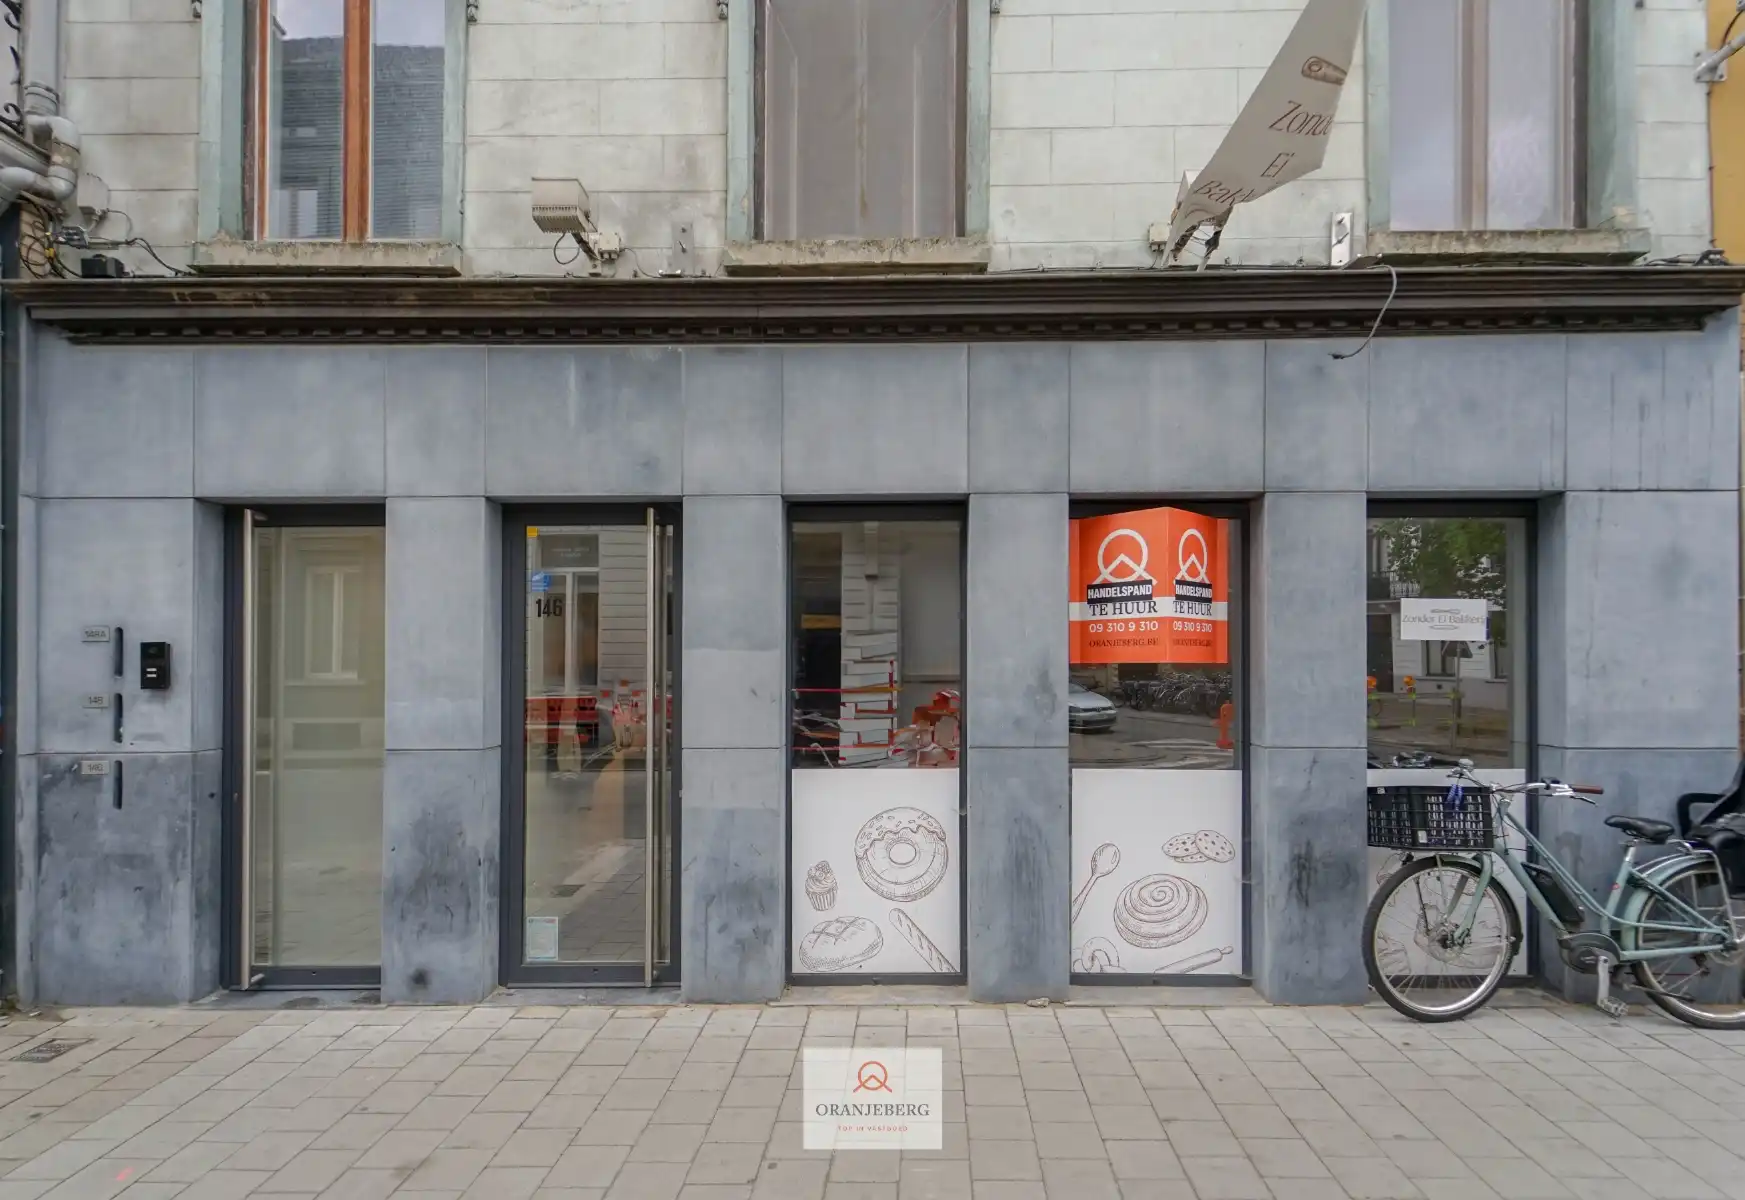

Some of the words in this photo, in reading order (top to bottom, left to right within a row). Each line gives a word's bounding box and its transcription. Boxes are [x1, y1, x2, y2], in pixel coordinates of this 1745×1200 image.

[1088, 585, 1152, 599] HANDELSPAND
[1175, 585, 1212, 598] HANDELSPAND
[536, 598, 563, 617] 146
[1089, 603, 1108, 616] TE
[1112, 601, 1158, 616] HUUR
[1173, 601, 1185, 614] TE
[1187, 602, 1212, 616] HUUR
[1089, 622, 1104, 633] 09
[1107, 622, 1125, 632] 310
[1128, 621, 1136, 631] 9
[1139, 620, 1159, 631] 310
[1173, 621, 1182, 631] 09
[1184, 621, 1195, 632] 310
[1195, 622, 1201, 632] 9
[1202, 622, 1212, 632] 310
